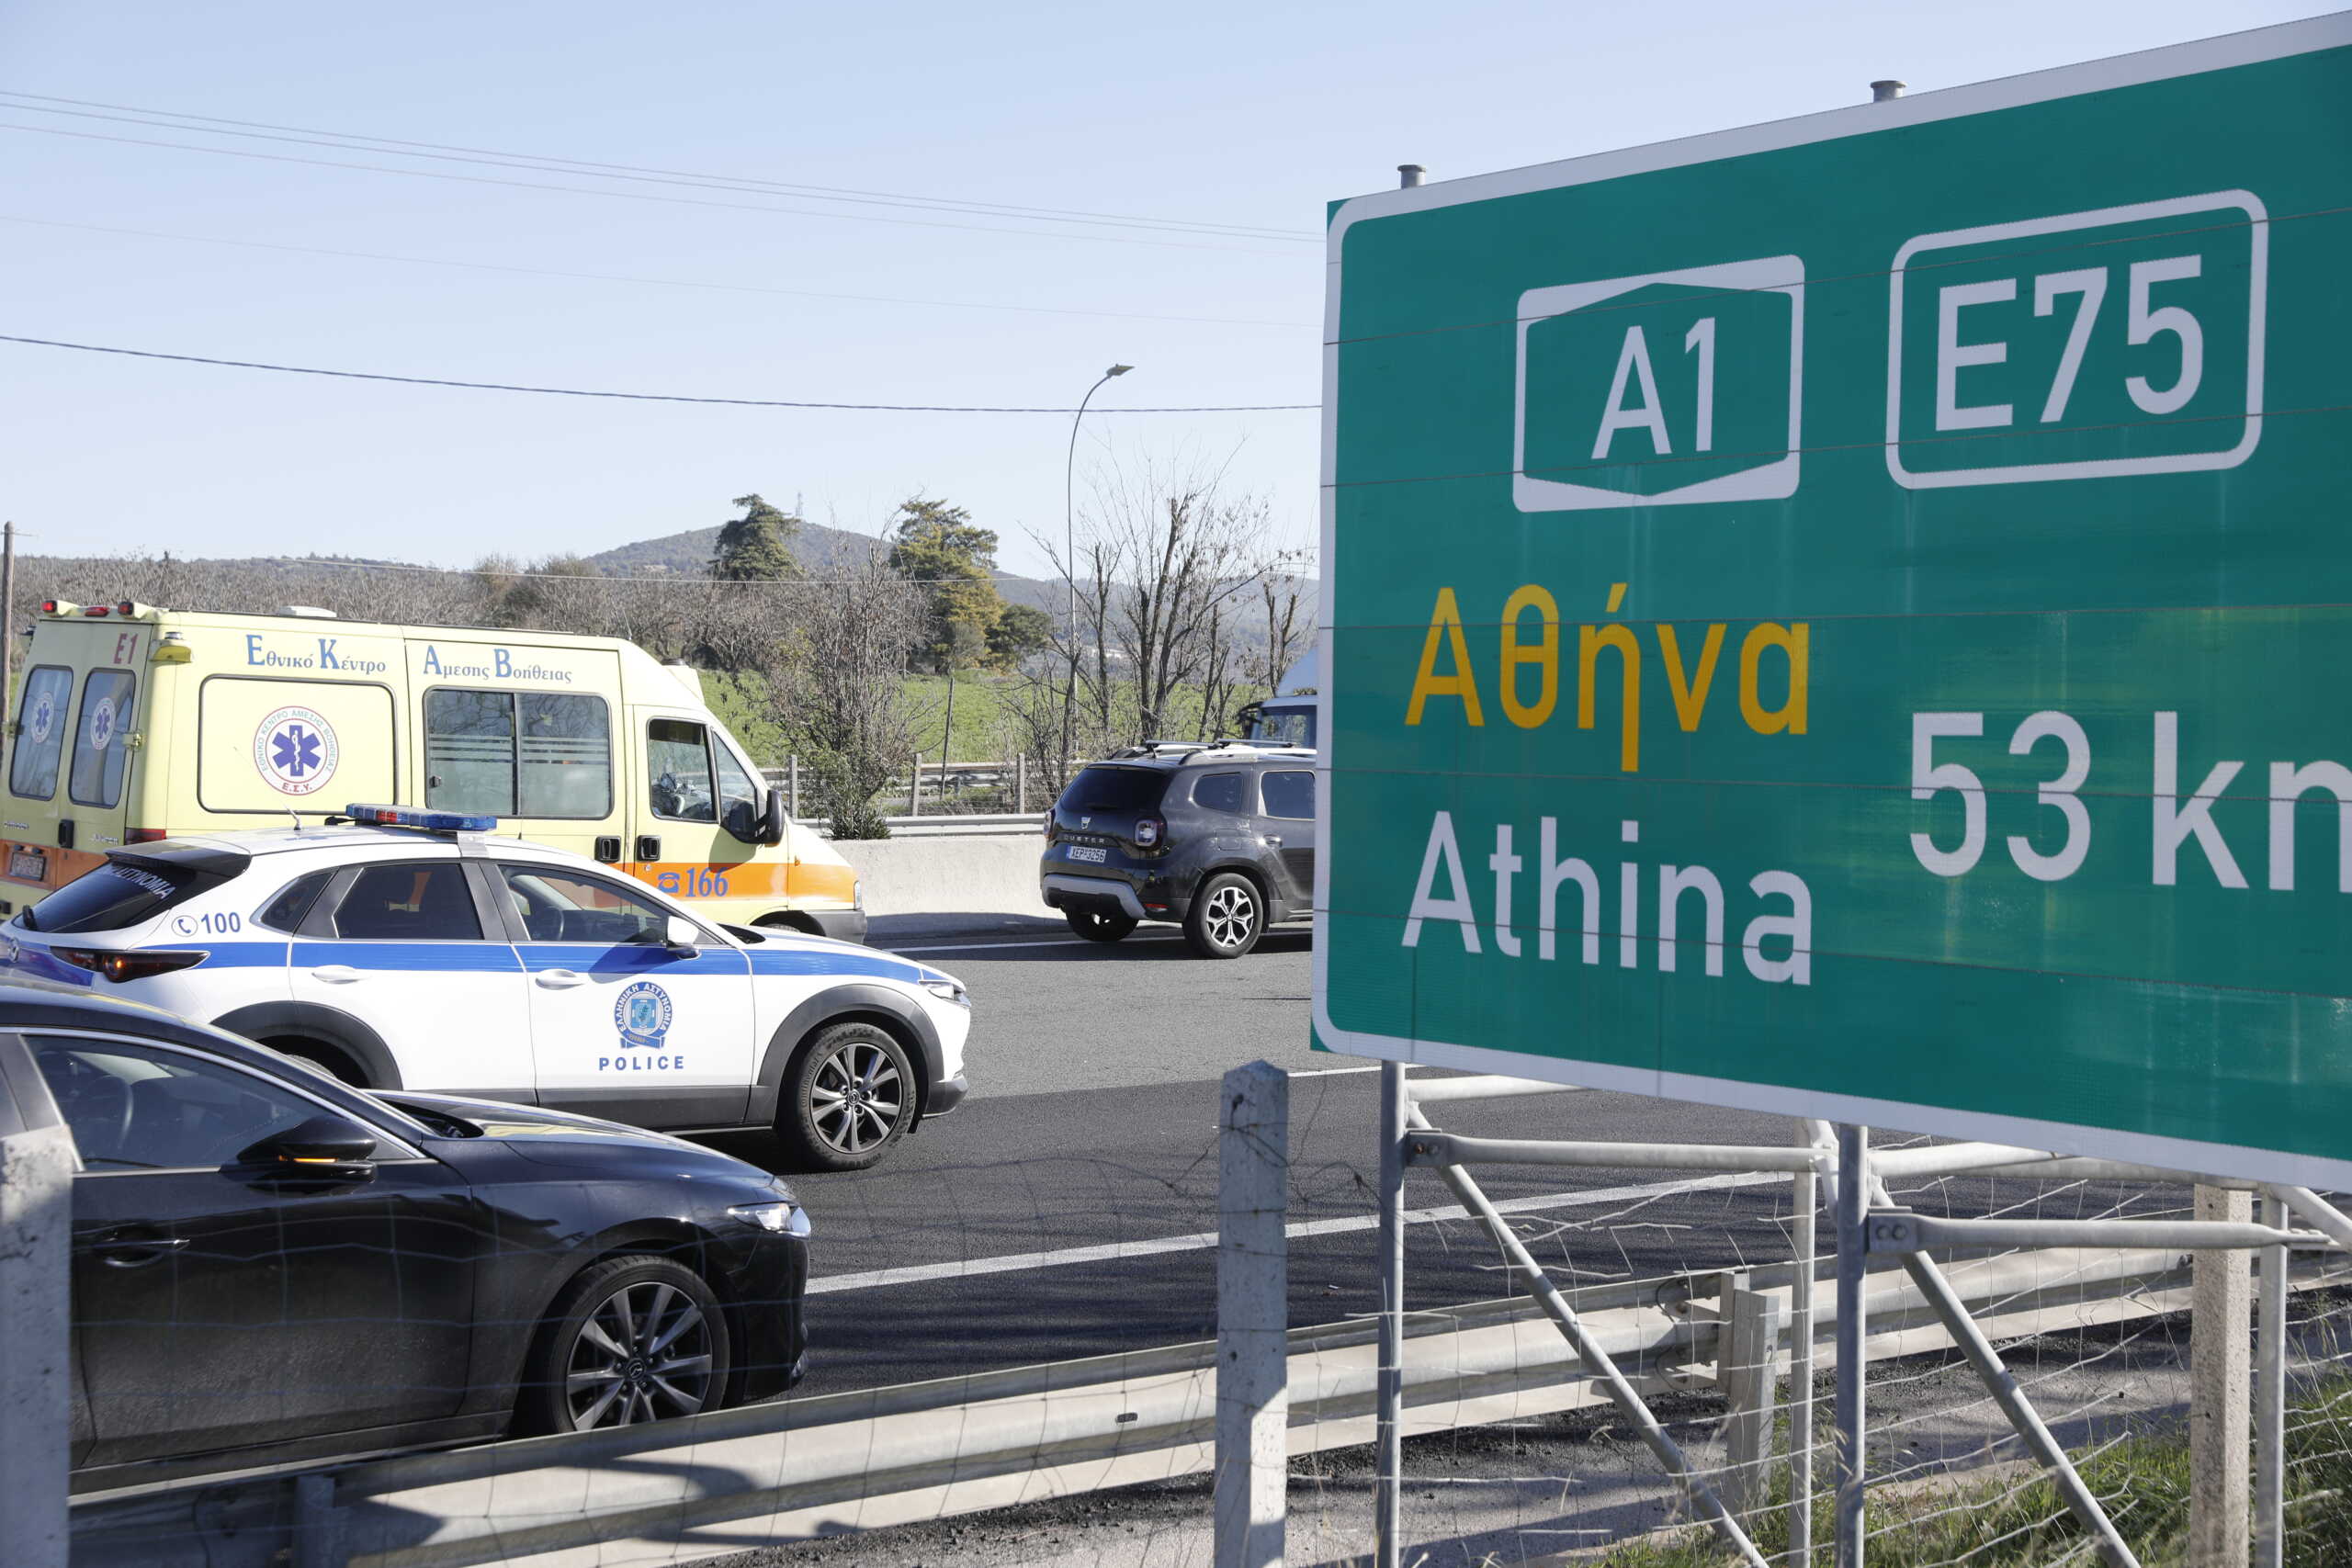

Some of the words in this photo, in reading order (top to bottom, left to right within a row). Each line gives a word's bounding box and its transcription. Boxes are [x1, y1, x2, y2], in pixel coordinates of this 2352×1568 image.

[1936, 255, 2202, 432] E75
[1591, 317, 1715, 459] A1
[113, 633, 139, 664] E1
[245, 634, 314, 668] Εθνικό
[318, 638, 387, 675] Κέντρο
[493, 649, 572, 683] Βοήθειας
[1406, 583, 1809, 773] Αθήνα
[1911, 711, 2090, 882] 53
[685, 867, 729, 897] 166
[1402, 811, 1812, 986] Athina
[200, 912, 241, 933] 100
[616, 984, 639, 1032] ΕΛΛΗΝΙΚΗ
[643, 982, 672, 1031] ΑΣΤΥΝΟΜΙΑ
[598, 1055, 684, 1071] POLICE
